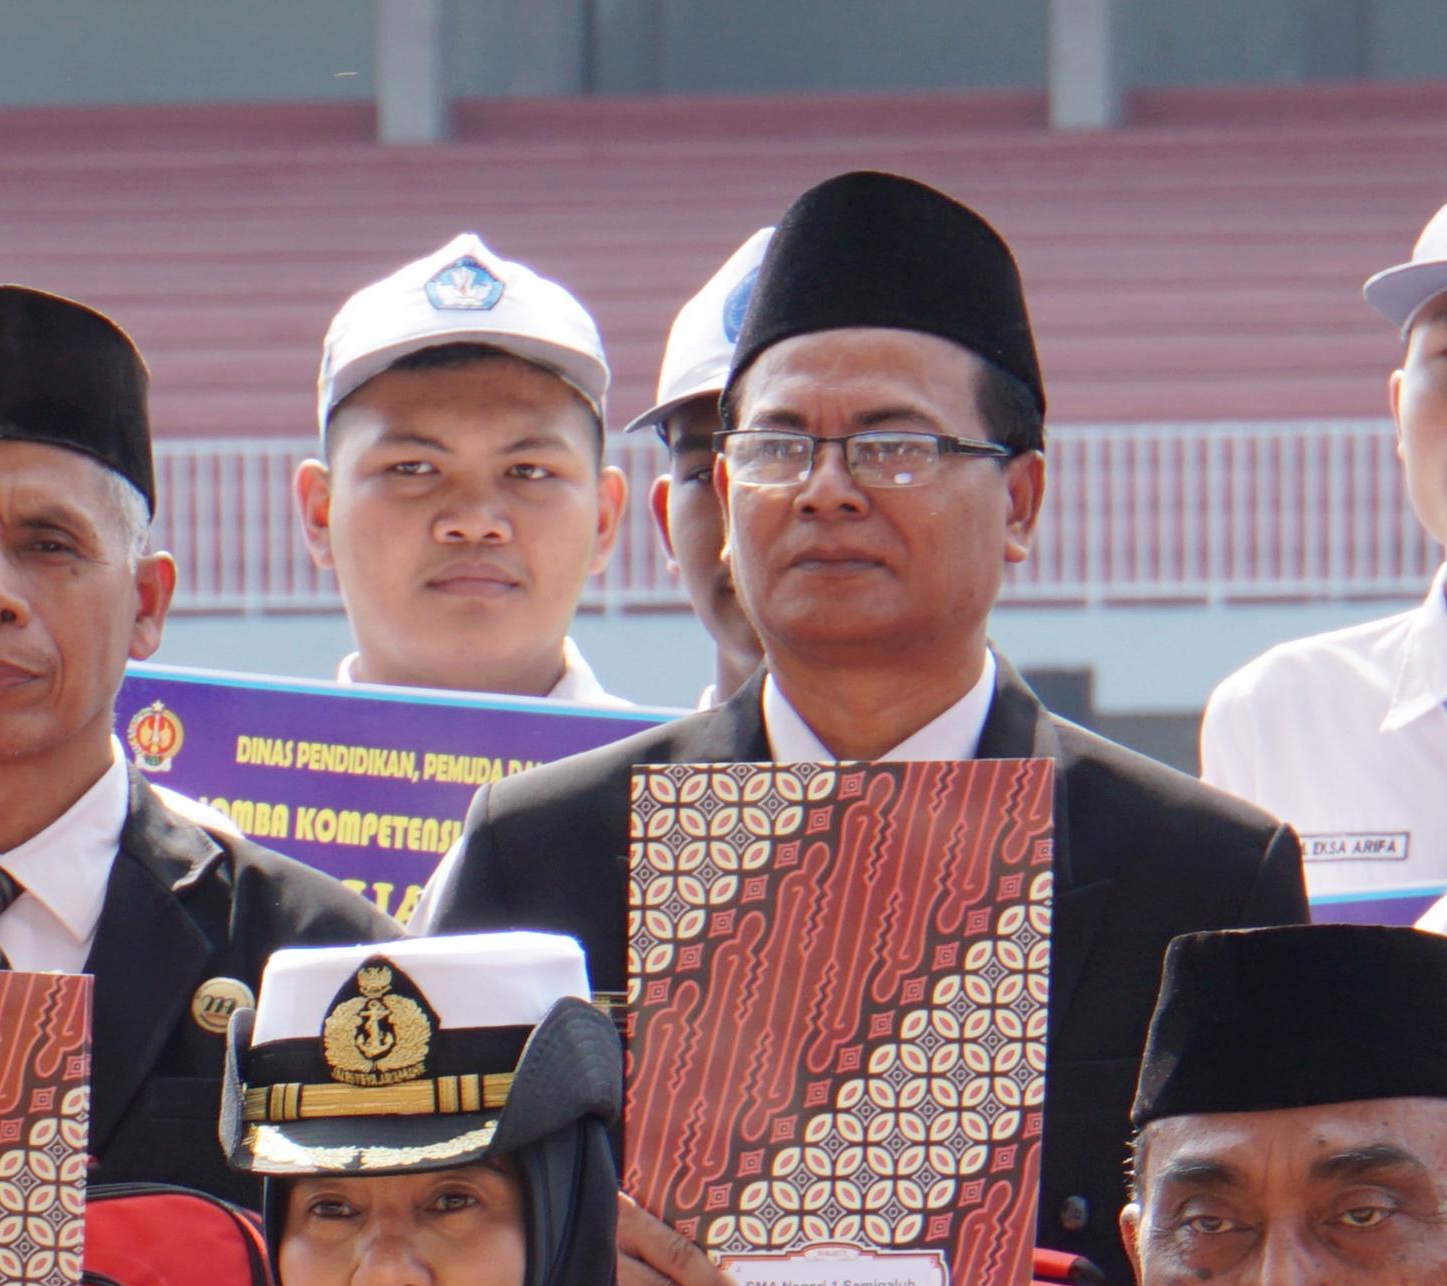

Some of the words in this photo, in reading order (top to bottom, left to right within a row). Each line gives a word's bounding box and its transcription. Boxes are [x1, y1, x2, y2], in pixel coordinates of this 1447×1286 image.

[236, 735, 294, 768] DINAS
[296, 741, 420, 783] PENDIDIKAN,
[423, 753, 507, 785] PEMUDA
